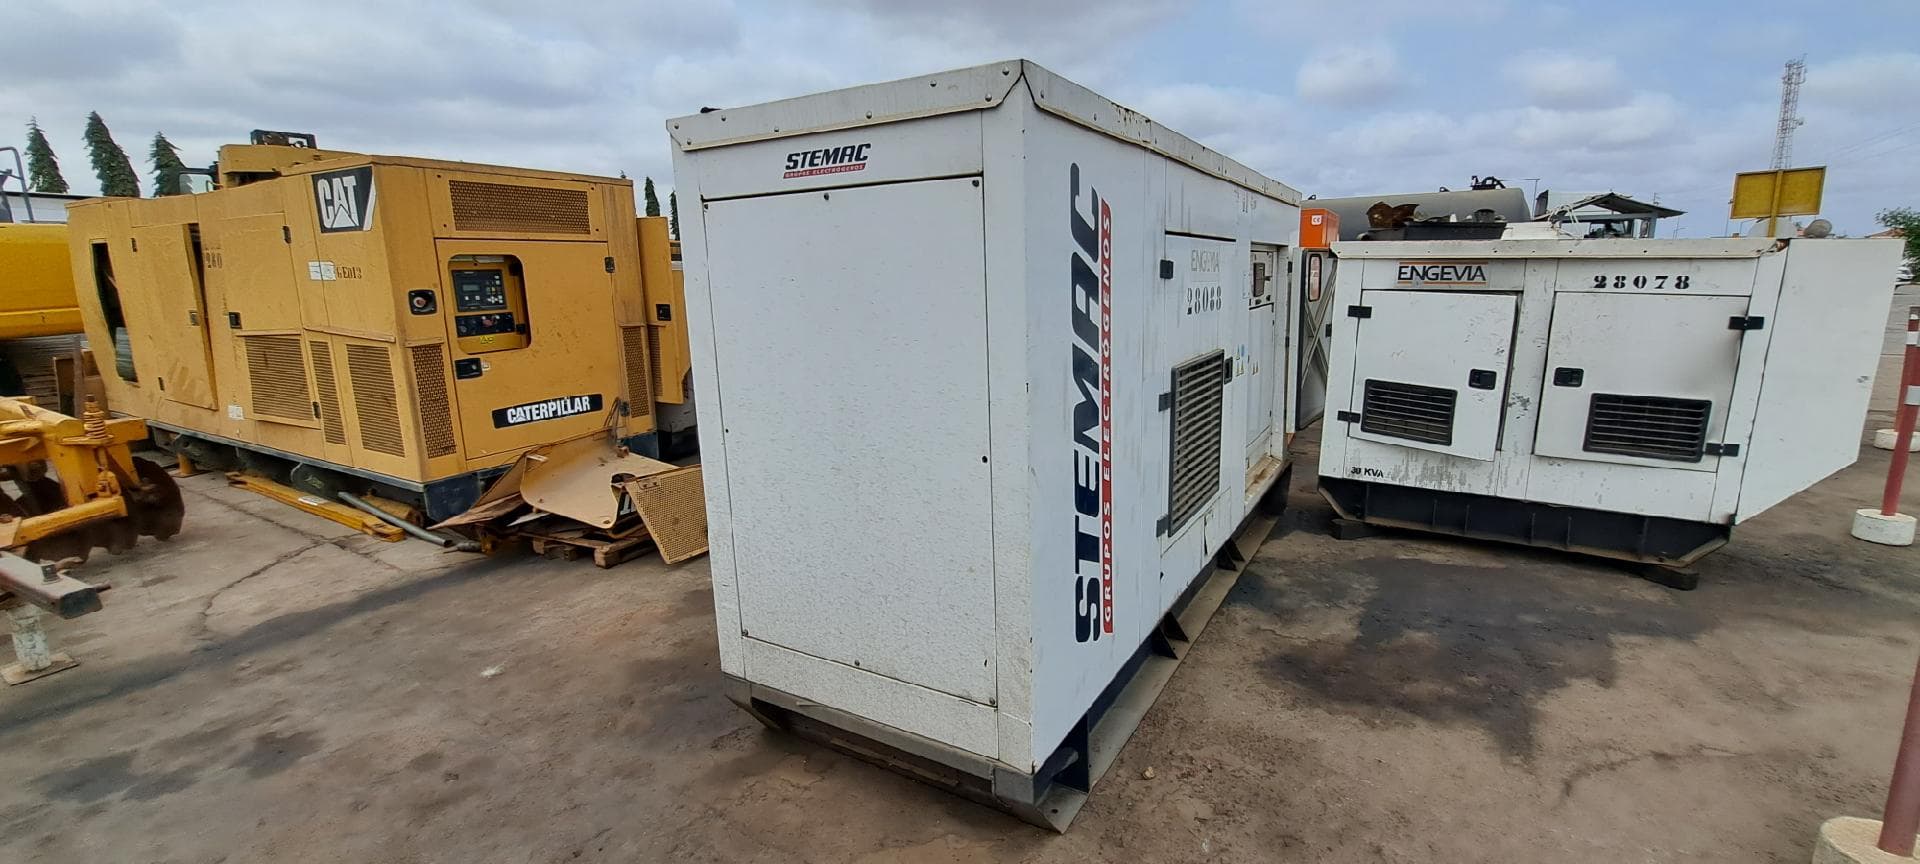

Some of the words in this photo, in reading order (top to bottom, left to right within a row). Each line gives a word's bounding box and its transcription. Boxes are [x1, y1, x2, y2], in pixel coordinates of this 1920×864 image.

[785, 143, 871, 170] STEMAC
[317, 175, 360, 229] CAT
[1397, 265, 1487, 281] ENGEVIA
[1592, 275, 1690, 290] 28078
[507, 396, 591, 424] CATERPILLAR
[1070, 162, 1100, 643] STEMAC
[1103, 501, 1112, 623] GRUPOS
